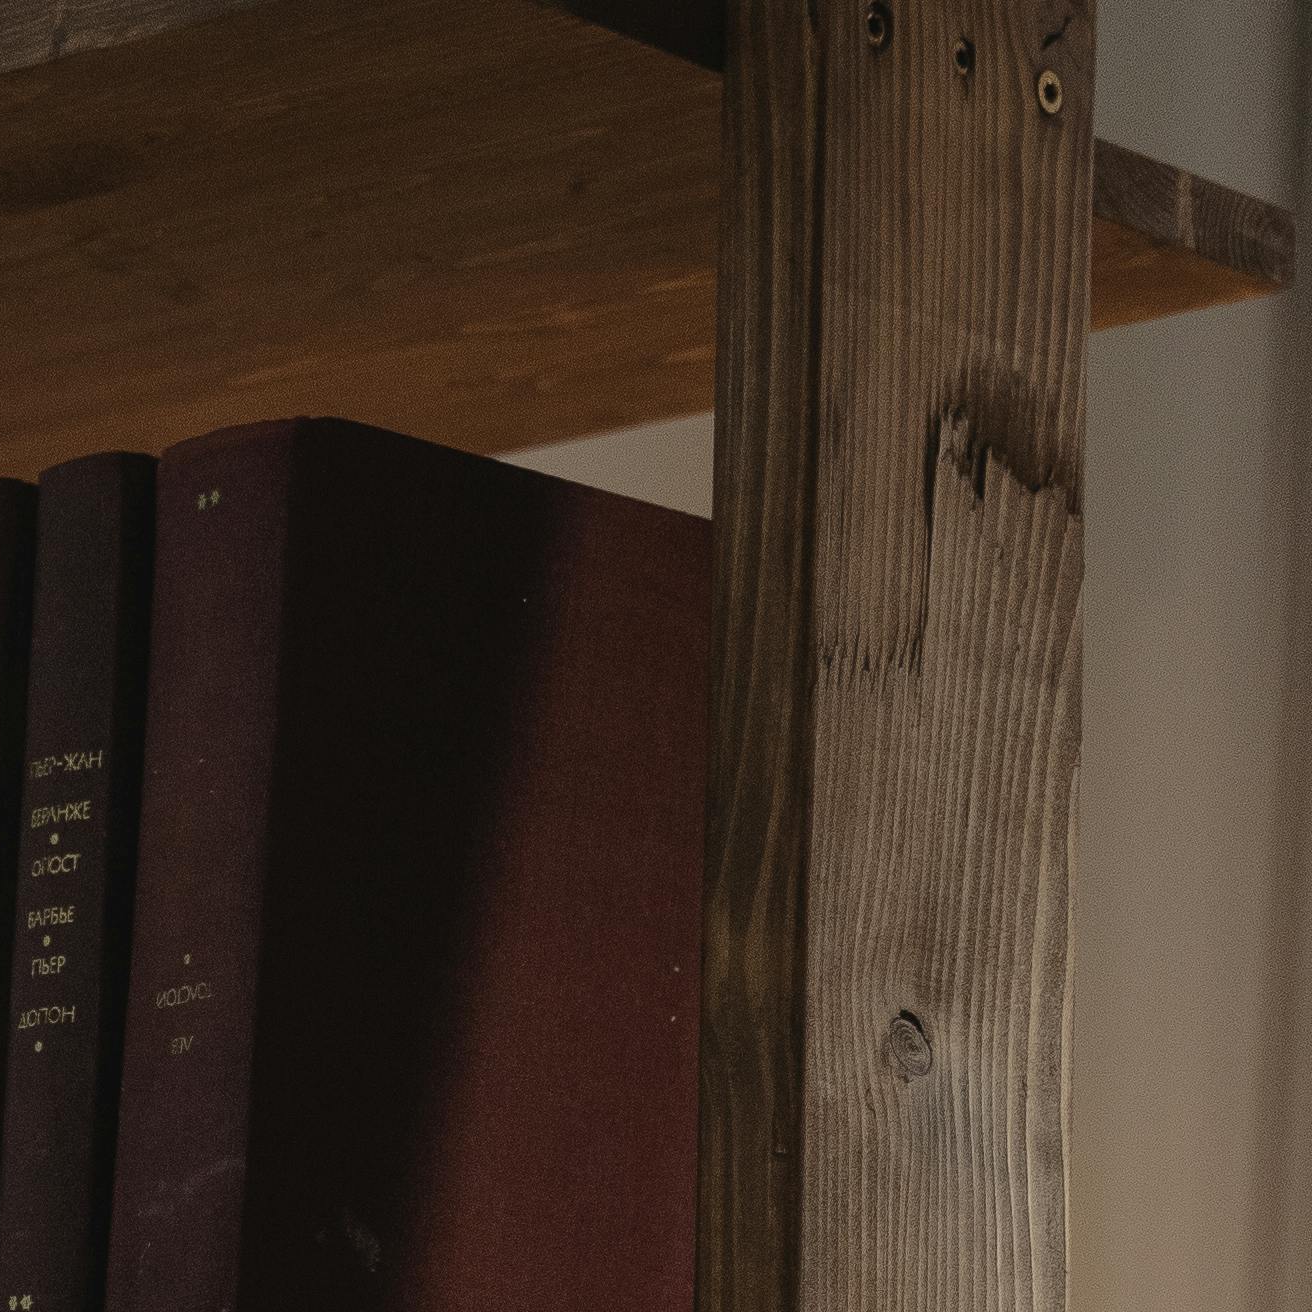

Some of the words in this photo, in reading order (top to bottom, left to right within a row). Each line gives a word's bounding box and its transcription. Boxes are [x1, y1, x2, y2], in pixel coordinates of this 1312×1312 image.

[29, 749, 105, 779] ПЬЕР-ЖАН
[30, 800, 92, 829] БЕРАНЖЕ
[27, 904, 76, 930] БАРБЬЕ
[30, 955, 67, 977] ПЬЕР
[18, 1005, 78, 1029] ДЮПОН
[170, 1034, 195, 1055] ЛЕВ
